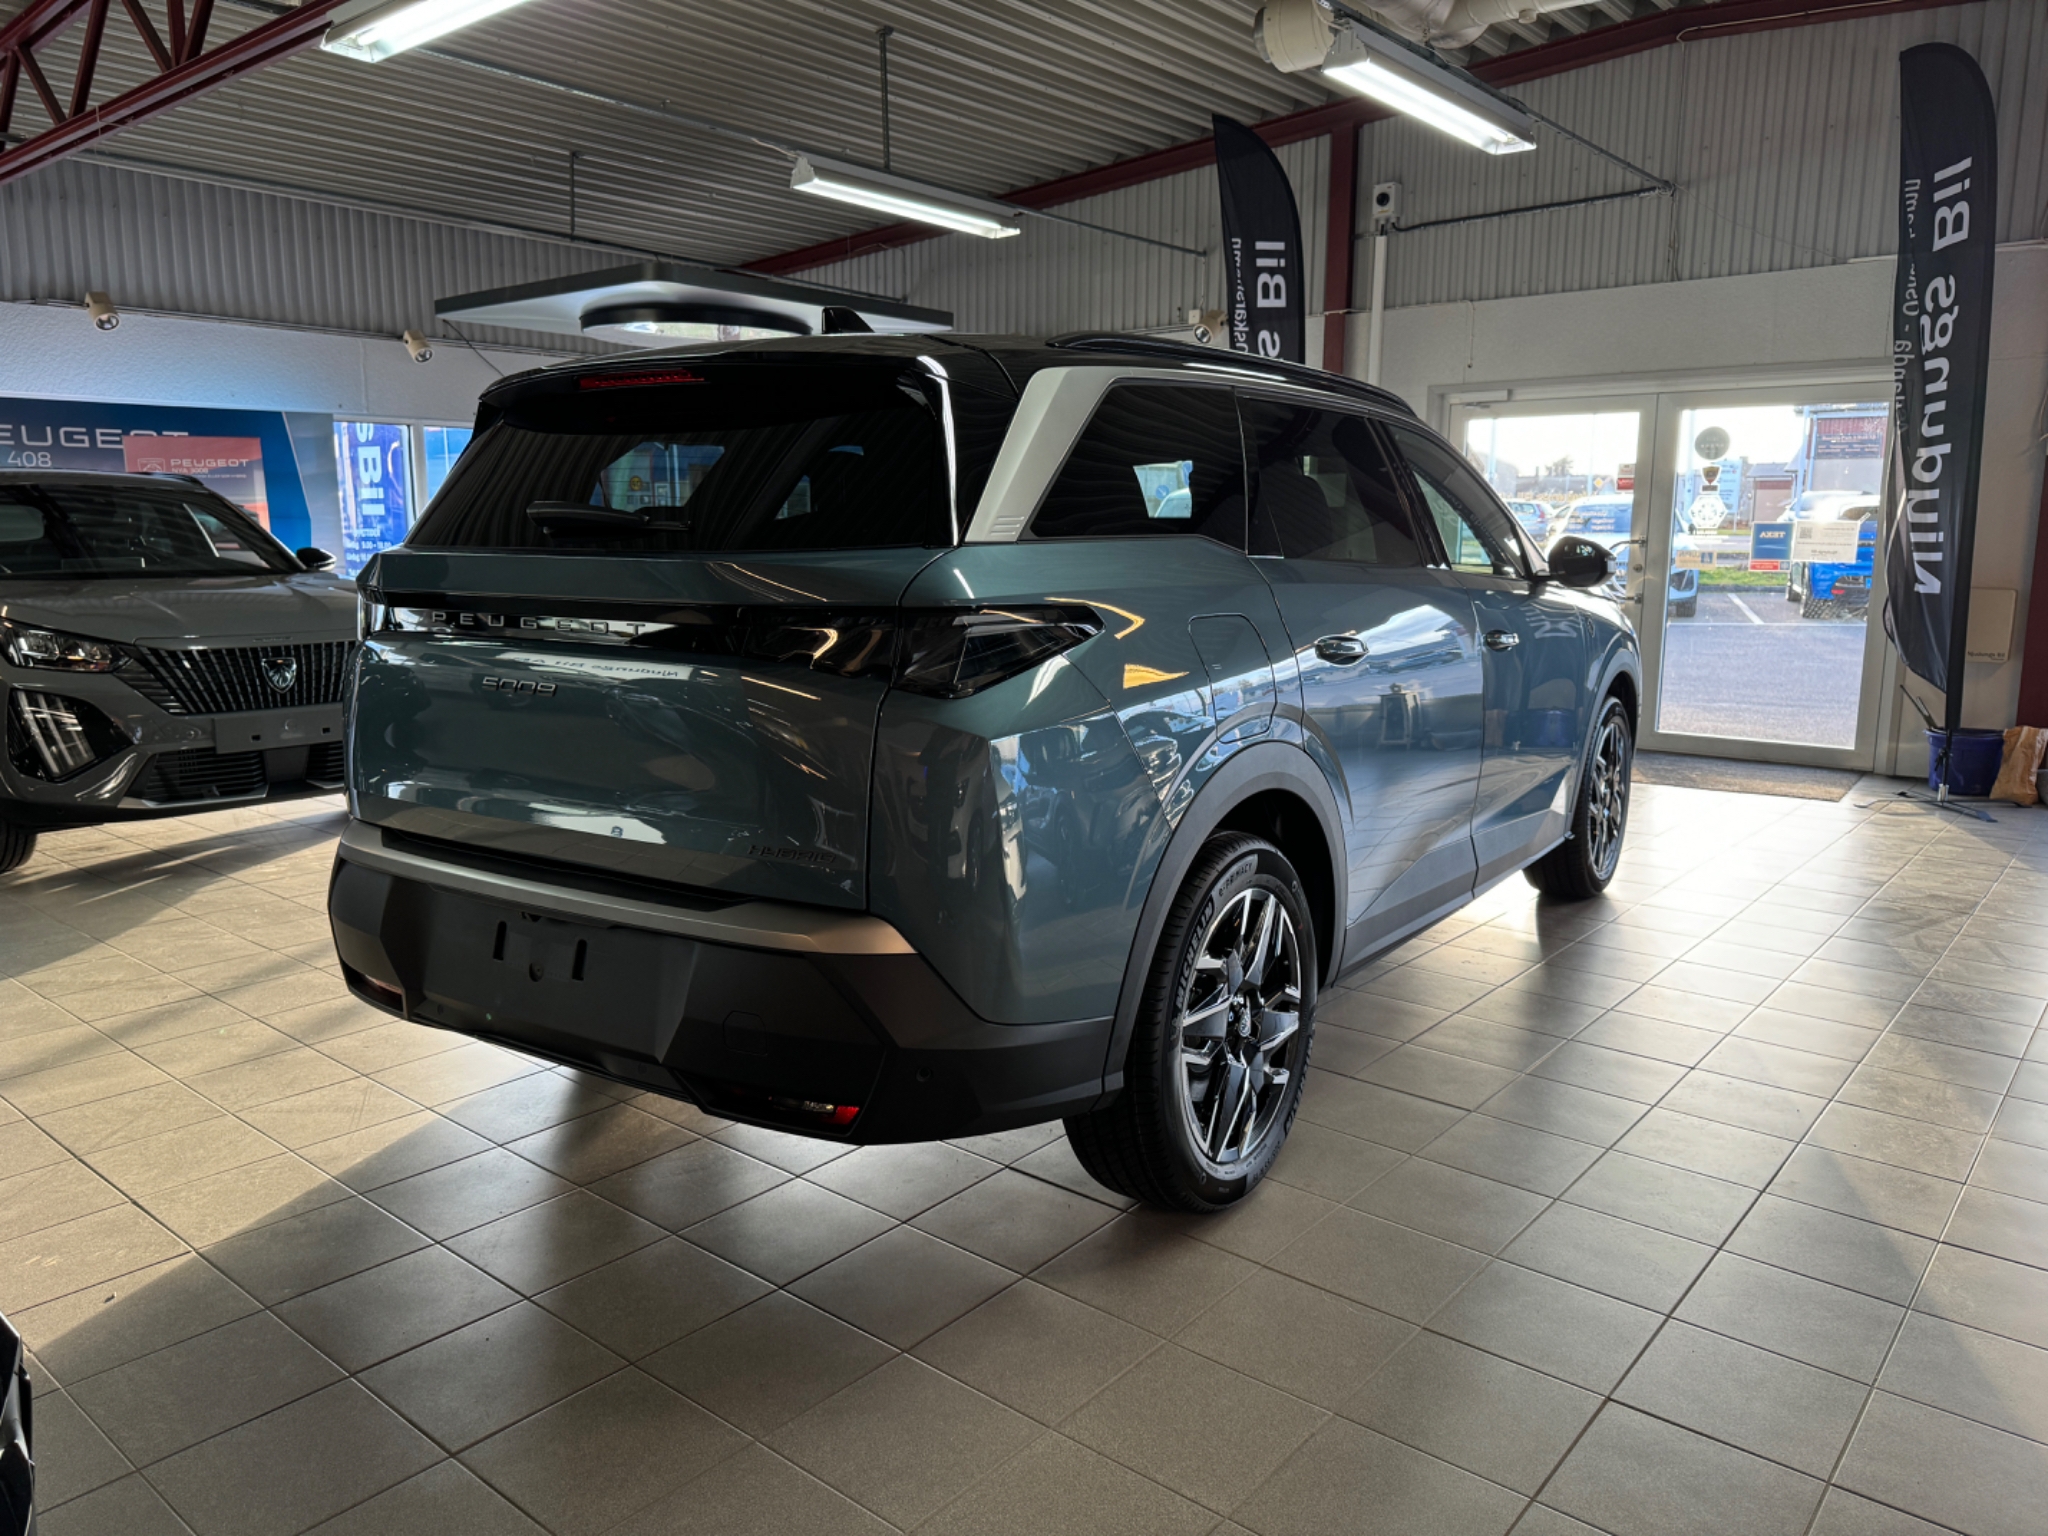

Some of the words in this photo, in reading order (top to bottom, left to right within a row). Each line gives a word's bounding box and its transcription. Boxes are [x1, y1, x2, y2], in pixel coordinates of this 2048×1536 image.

[0, 424, 189, 449] EUGE
[7, 450, 52, 468] 408
[170, 458, 249, 467] PEUGEOT
[357, 446, 385, 516] Bil
[431, 611, 646, 636] PEUGEOT
[481, 675, 559, 697] 5008
